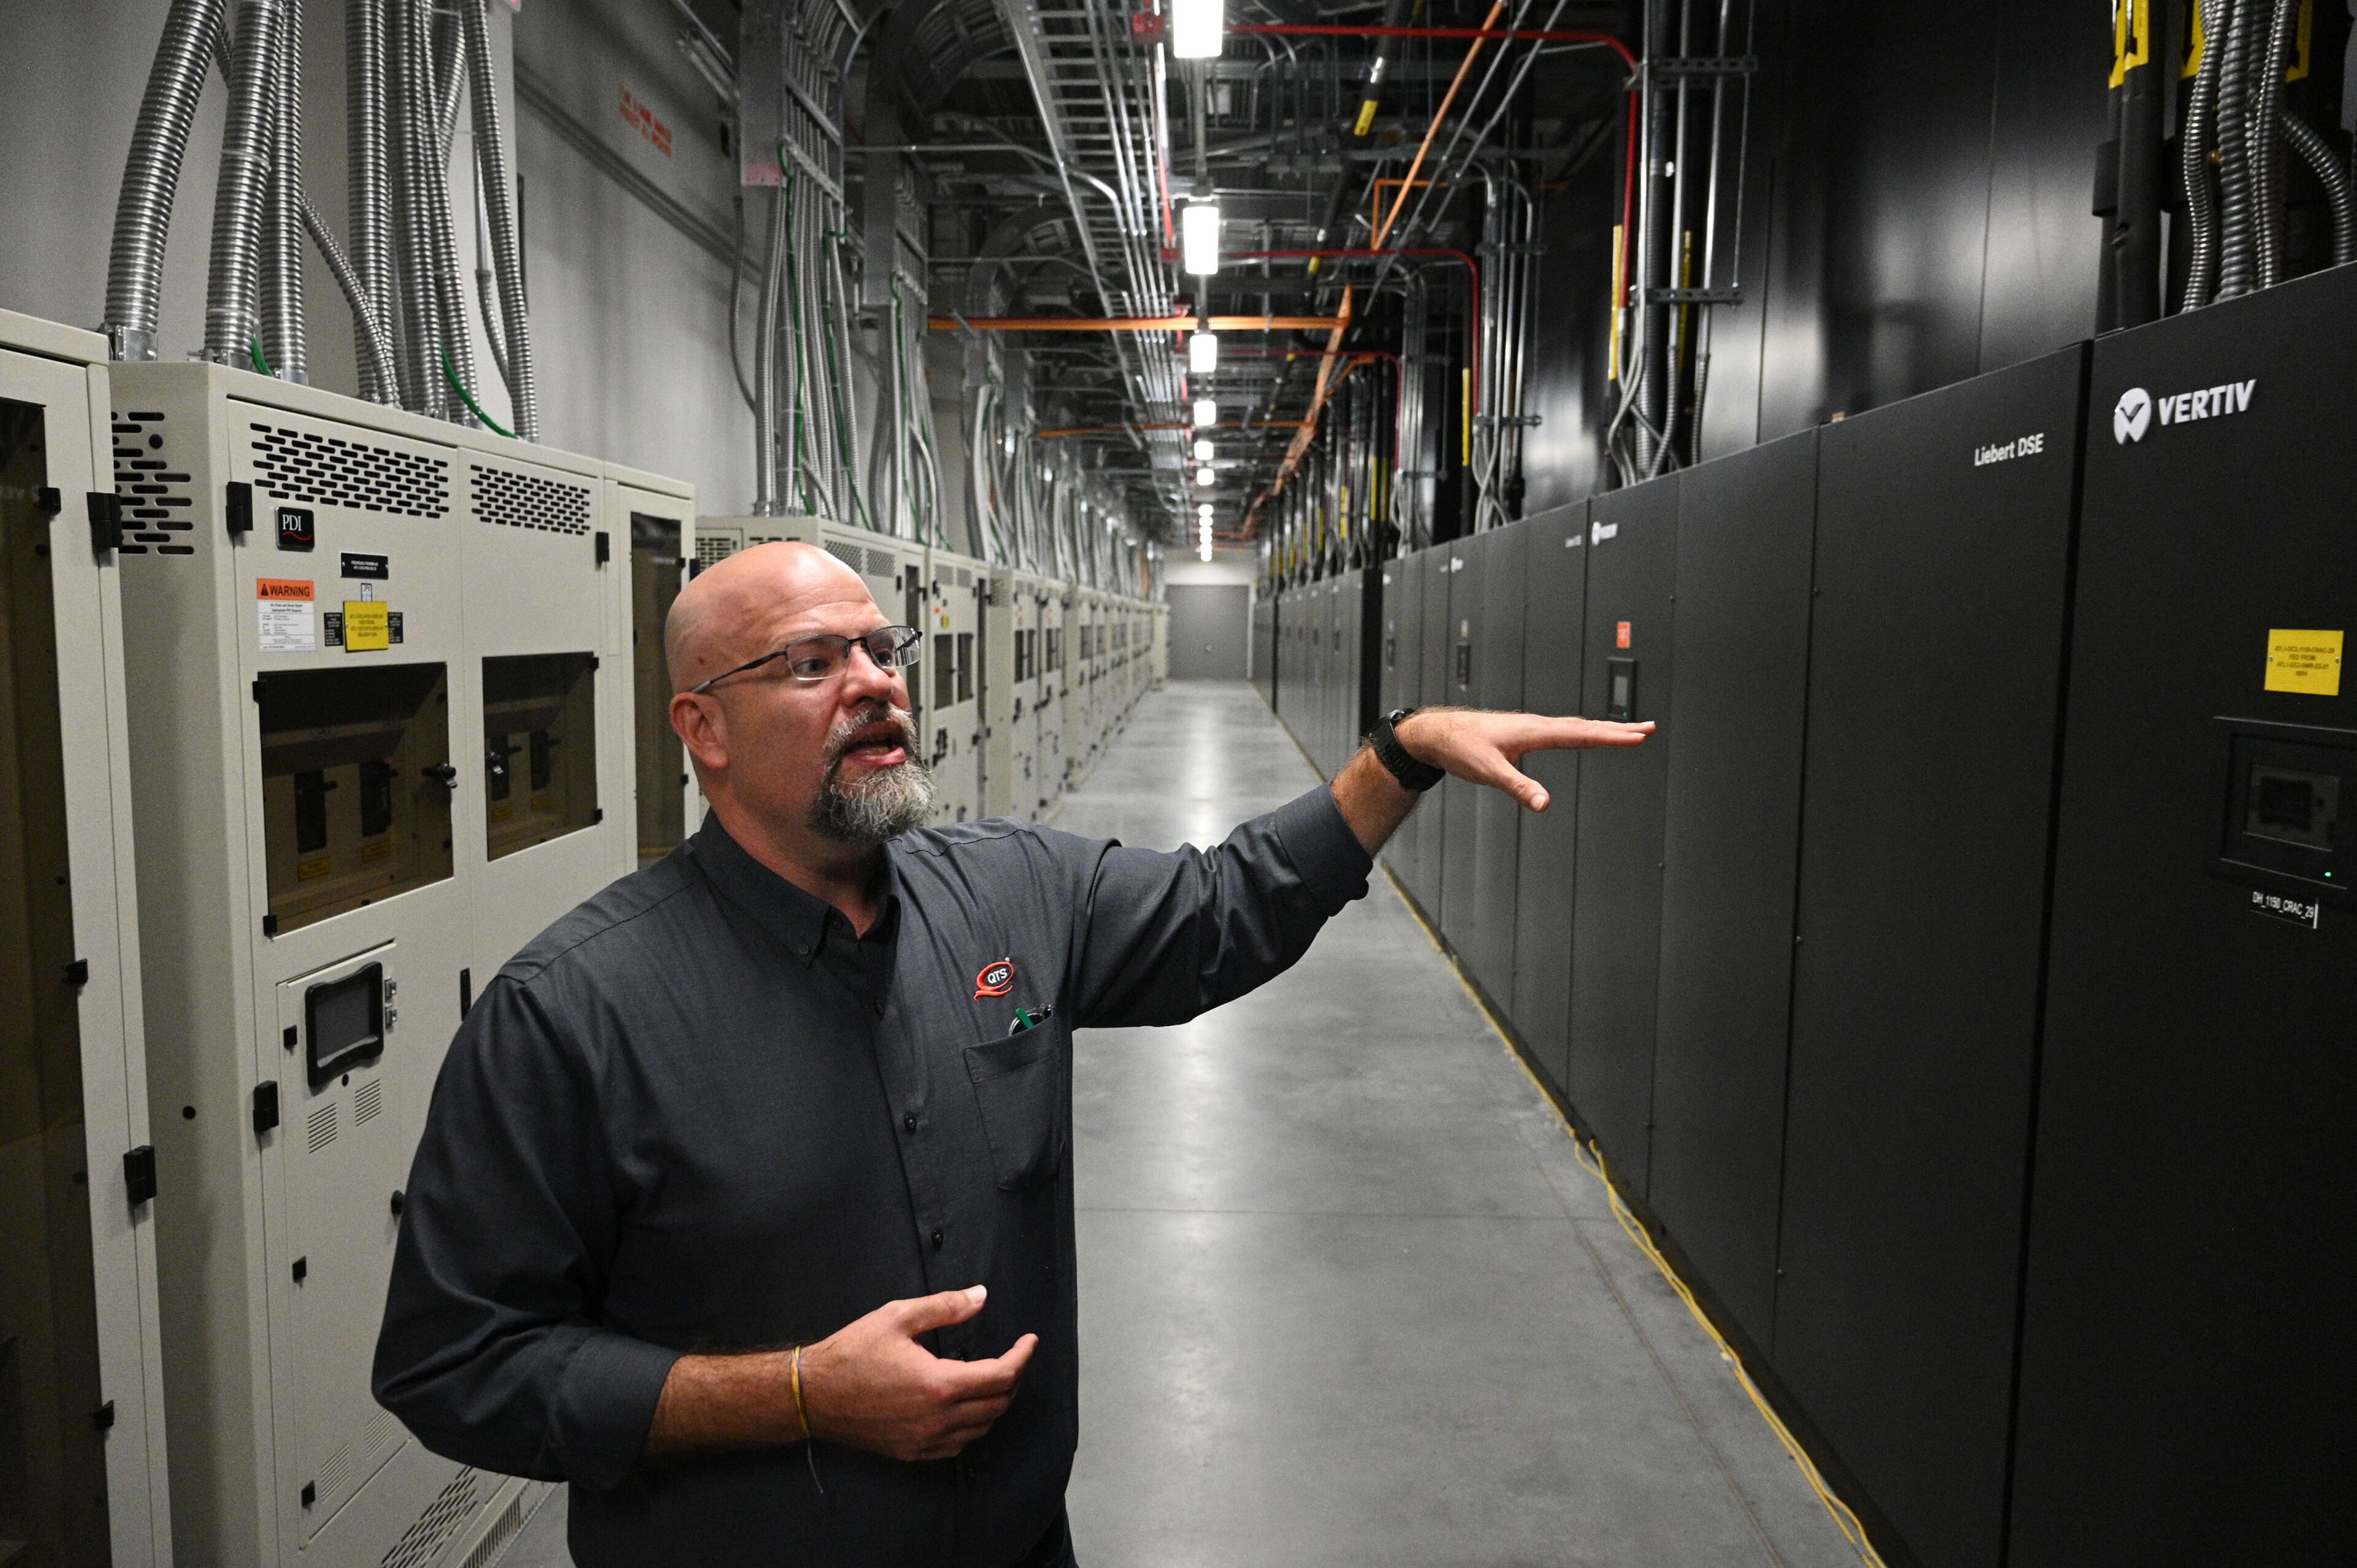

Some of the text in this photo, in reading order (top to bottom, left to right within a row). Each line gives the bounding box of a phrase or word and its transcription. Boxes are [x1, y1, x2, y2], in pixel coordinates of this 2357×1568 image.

[2158, 379, 2257, 426] VERTIV
[1975, 433, 2045, 466] Liebert DSE
[282, 514, 301, 531] PDI
[269, 585, 310, 597] WARNING
[2252, 891, 2315, 919] DH_1150_CRAC_29
[987, 968, 1008, 984] QTS
